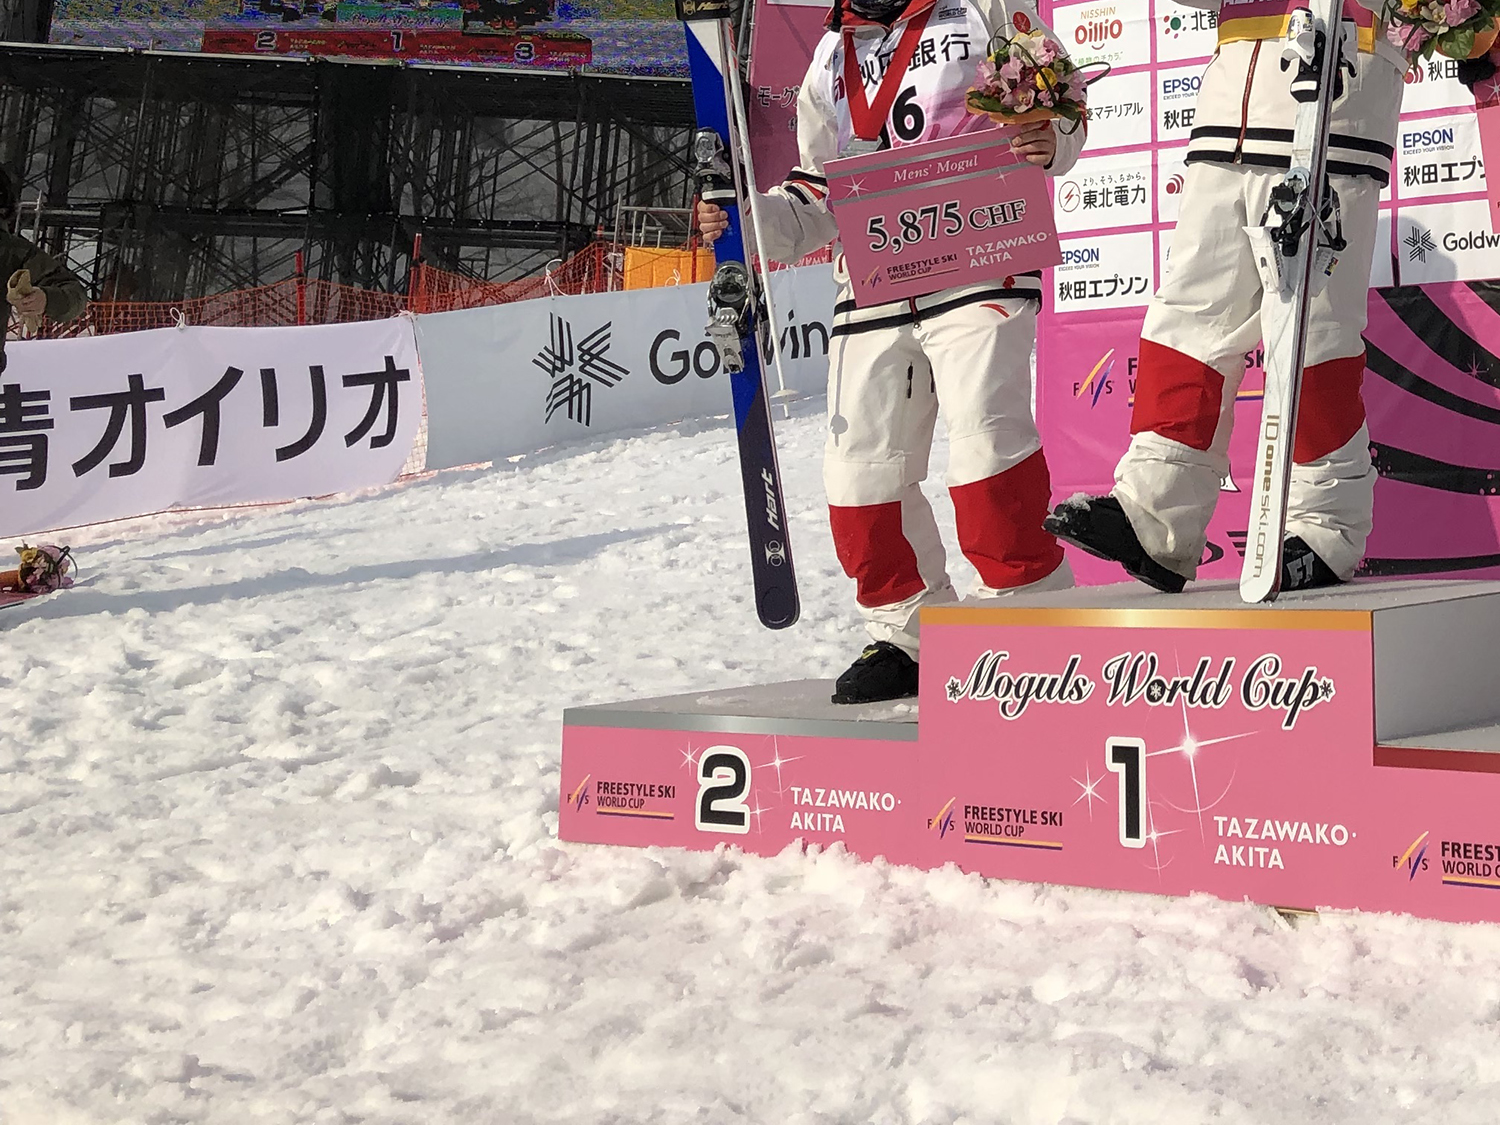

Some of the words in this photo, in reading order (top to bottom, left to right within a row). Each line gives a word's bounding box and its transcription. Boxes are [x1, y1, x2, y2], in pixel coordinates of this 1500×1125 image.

[1080, 7, 1116, 19] NISSHIN
[1402, 128, 1454, 149] EPSON
[936, 155, 979, 178] Mogul
[1083, 186, 1147, 209] 東北電力
[866, 200, 964, 254] 5,875
[967, 199, 1027, 230] CHF
[886, 256, 938, 275] FREESTYLE
[940, 253, 958, 264] SKI
[969, 251, 1013, 269] AKITA
[1060, 248, 1100, 265] EPSON
[888, 270, 914, 281] WORLD
[1059, 274, 1148, 301] 秋田エプソン
[958, 650, 1095, 720] Moguls
[1103, 651, 1233, 708] World
[1242, 653, 1323, 729] Cup
[596, 781, 656, 797] FREESTYLE
[657, 785, 676, 799] SKI
[697, 749, 749, 831] 2
[1108, 740, 1144, 844] 1
[597, 796, 627, 809] WORLD
[628, 797, 645, 809] CUP
[790, 812, 846, 833] AKITA
[964, 805, 1038, 825] FREESTYLE
[1040, 810, 1063, 827] SKI
[964, 822, 1002, 836] WORLD
[1004, 824, 1025, 838] CUP
[1214, 845, 1286, 870] AKITA
[1441, 859, 1493, 878] WORLD
